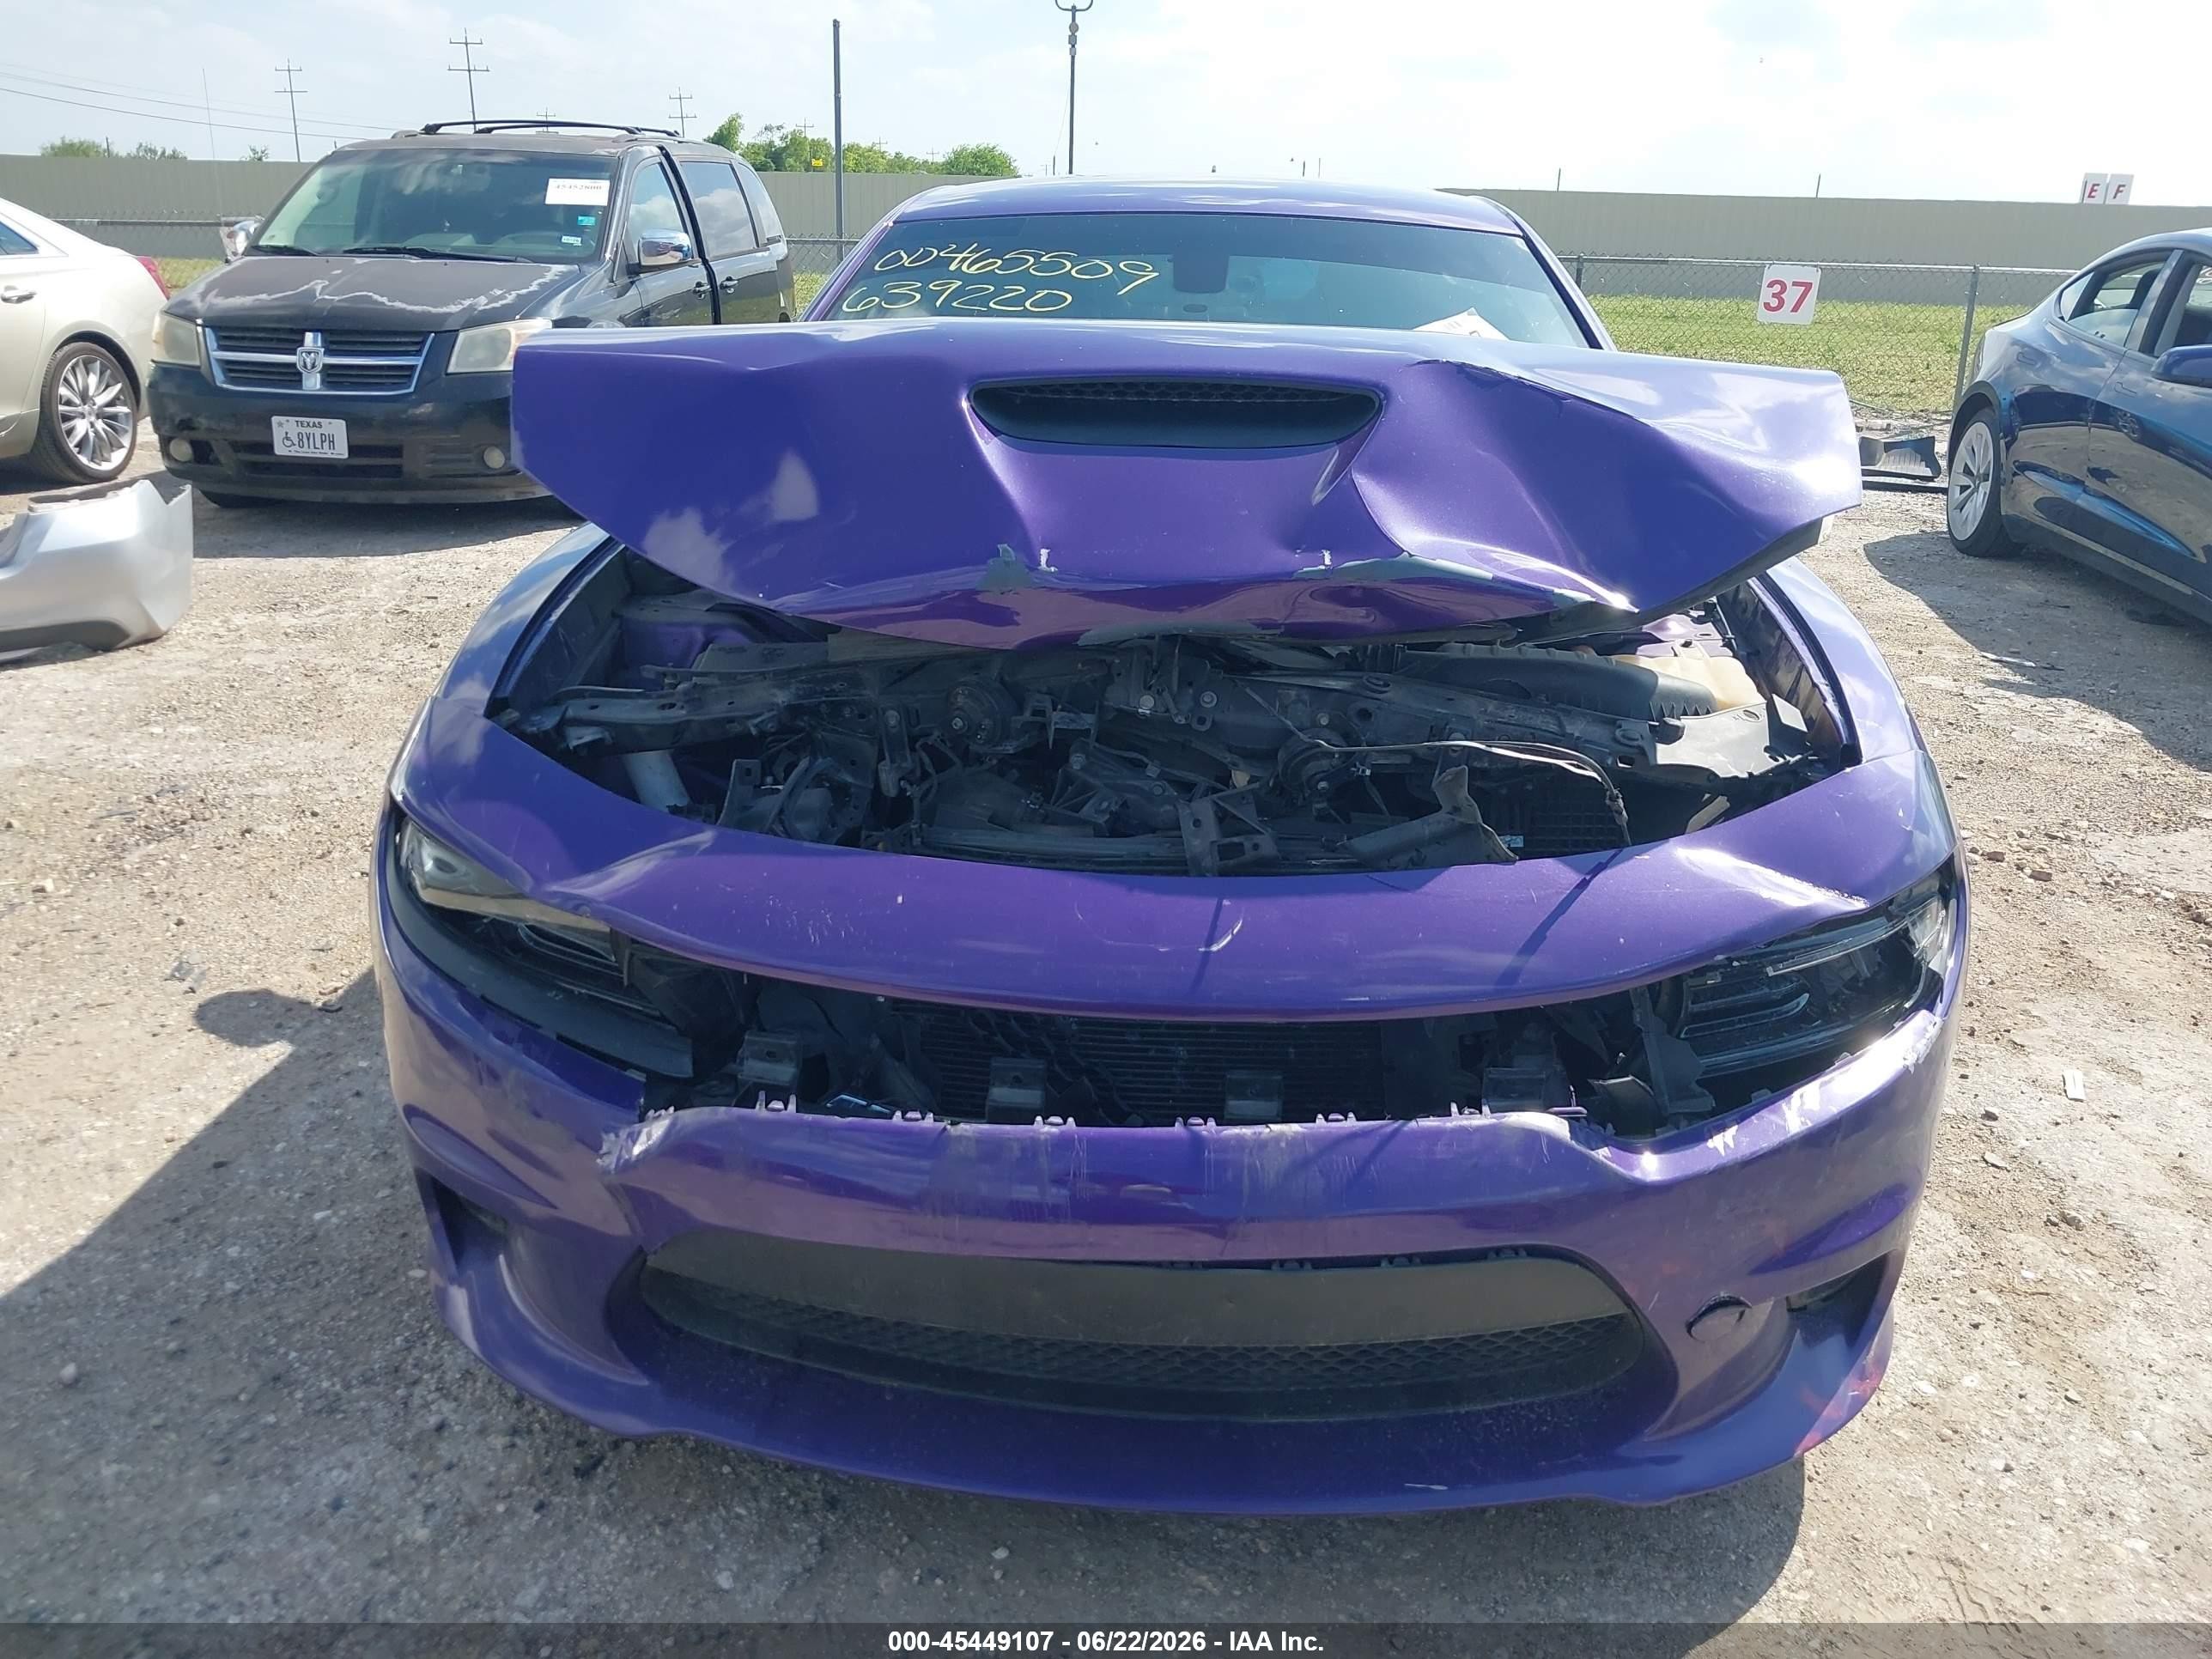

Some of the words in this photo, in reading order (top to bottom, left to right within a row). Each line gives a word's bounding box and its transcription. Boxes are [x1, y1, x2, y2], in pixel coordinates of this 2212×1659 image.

[2087, 183, 2100, 198] E
[2113, 184, 2126, 199] F
[874, 243, 1159, 295] 00465509
[842, 280, 1073, 312] 639220
[1763, 279, 1813, 313] 37
[295, 420, 323, 428] TEXAS
[297, 432, 335, 450] 8YLPH
